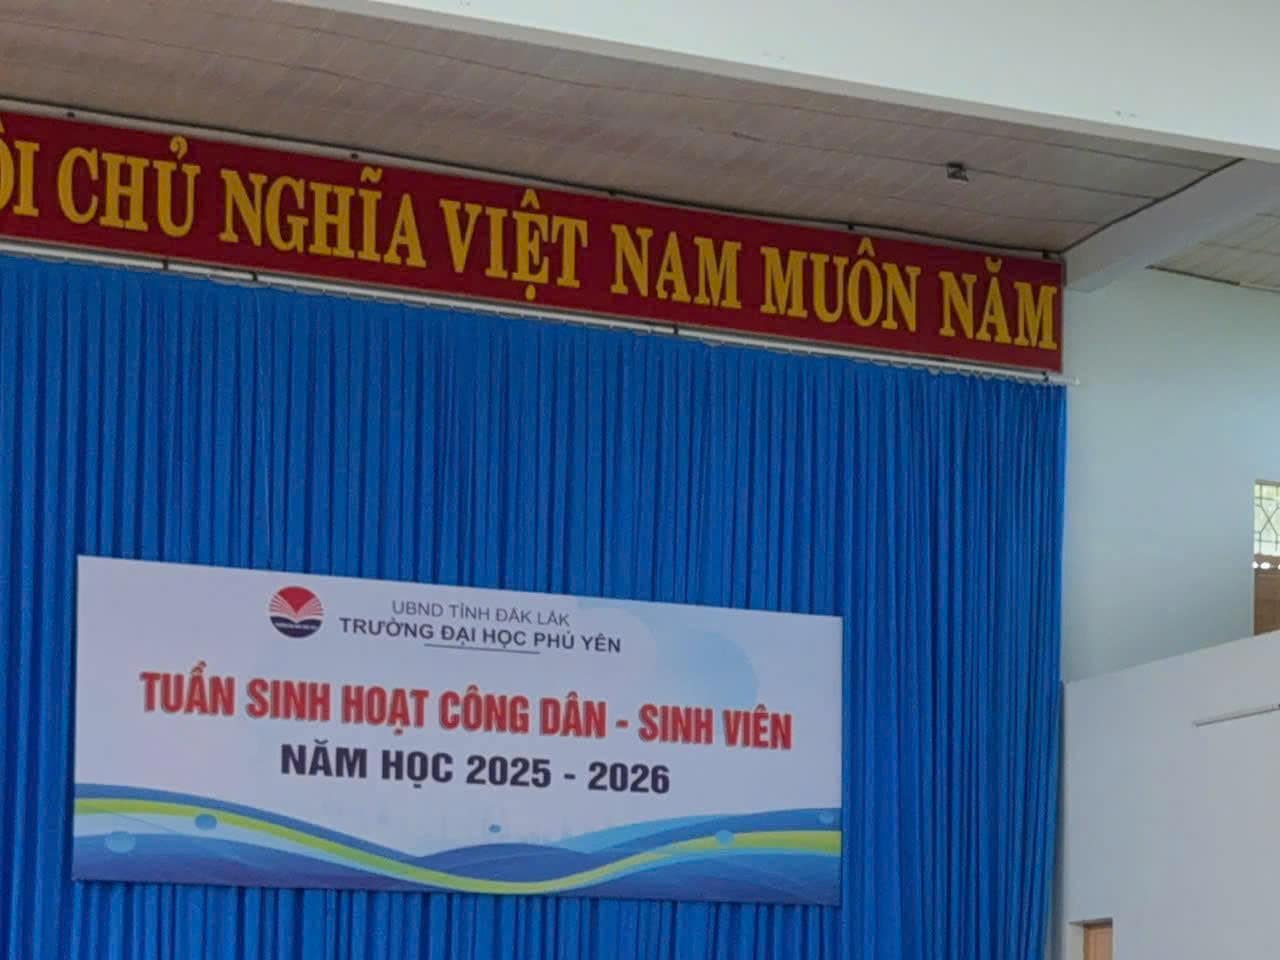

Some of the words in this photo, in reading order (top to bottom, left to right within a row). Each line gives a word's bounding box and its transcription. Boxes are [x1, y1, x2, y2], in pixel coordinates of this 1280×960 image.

[57, 135, 201, 238] CHỦ
[218, 165, 427, 268] NGHĨA
[439, 188, 588, 300] VIỆT
[610, 222, 742, 311] NAM
[759, 236, 922, 333] MUÔN
[938, 256, 1059, 351] NĂM
[339, 616, 435, 640] TRƯỜNG
[441, 624, 477, 646] ĐẠI
[482, 627, 527, 649] HỌC
[581, 631, 622, 654] YÊN
[391, 599, 444, 618] UBND
[246, 677, 331, 722] SINH
[340, 684, 430, 736] HOẠT
[438, 684, 530, 736] CÔNG
[538, 691, 607, 739] DÂN
[638, 702, 714, 745] SINH
[722, 703, 794, 750] VIÊN
[280, 738, 369, 779] NĂM
[381, 749, 453, 789] HỌC
[465, 754, 552, 788] 2025
[587, 761, 670, 794] 2026
